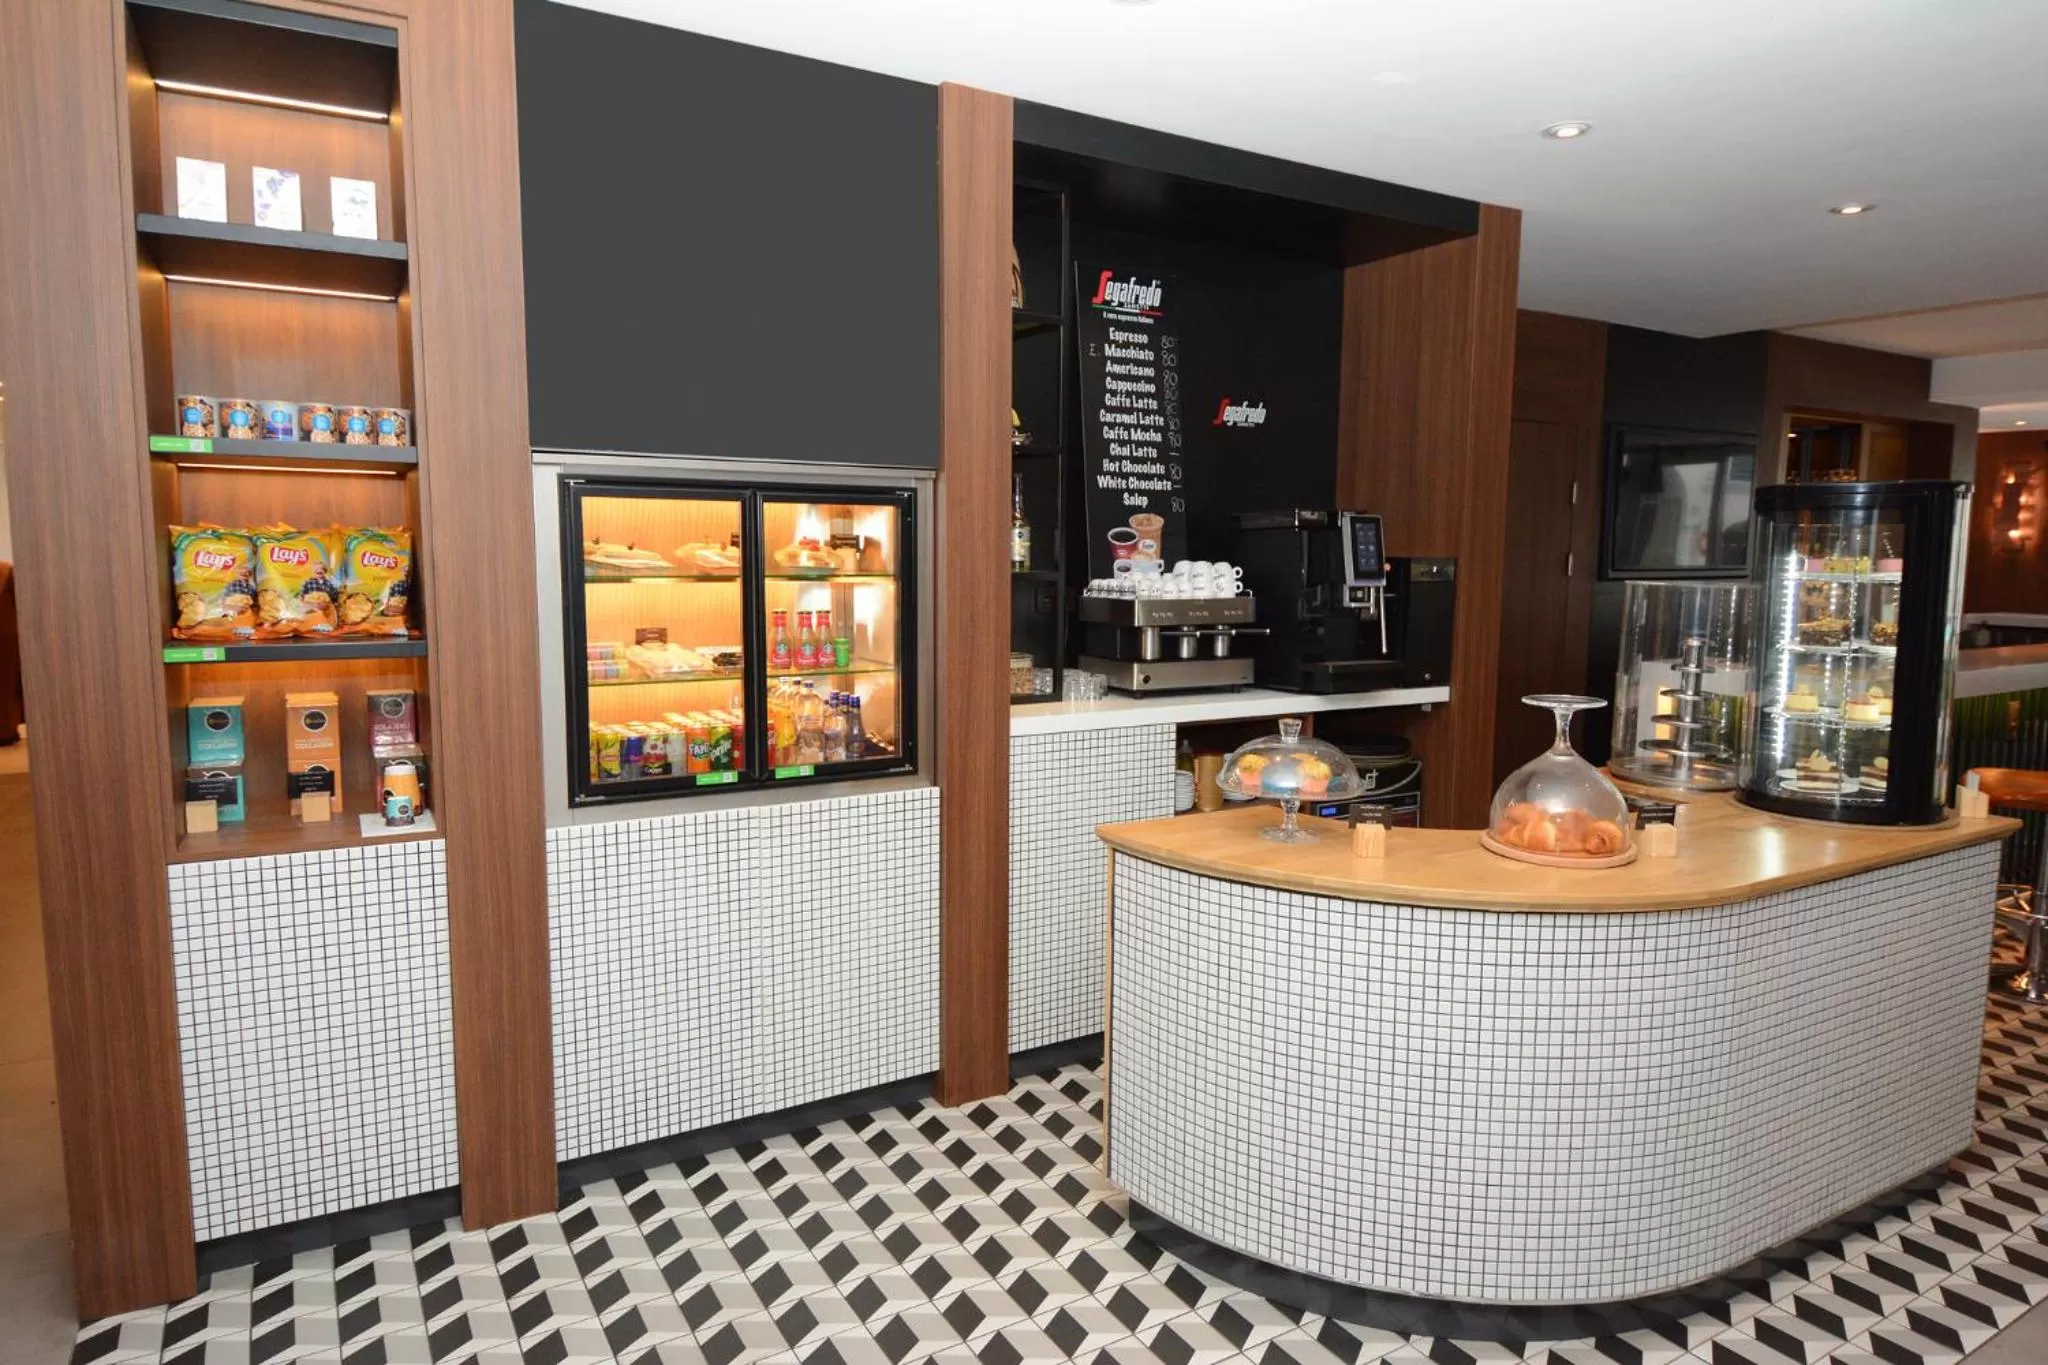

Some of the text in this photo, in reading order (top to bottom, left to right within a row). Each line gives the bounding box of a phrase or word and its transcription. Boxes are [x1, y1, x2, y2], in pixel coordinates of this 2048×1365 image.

[1092, 270, 1162, 307] Segafredo
[1109, 327, 1149, 344] Espresso
[1104, 343, 1154, 361] Macchiato
[1105, 360, 1155, 377] Americano
[1105, 376, 1156, 394] Cappuccino
[1105, 393, 1158, 409] Caffe Latte
[1100, 408, 1164, 426] Caramel Latte
[1213, 398, 1267, 427] Segafredo
[1103, 425, 1163, 442] Caffe Mocha
[1109, 442, 1157, 458] Chai Latte
[1103, 458, 1165, 474] Hot Chocolate
[1097, 475, 1172, 491] White Chocolate
[1123, 492, 1148, 508] Salep
[196, 550, 233, 569] Lay's
[271, 546, 307, 565] Lay's
[364, 552, 396, 568] Lay's
